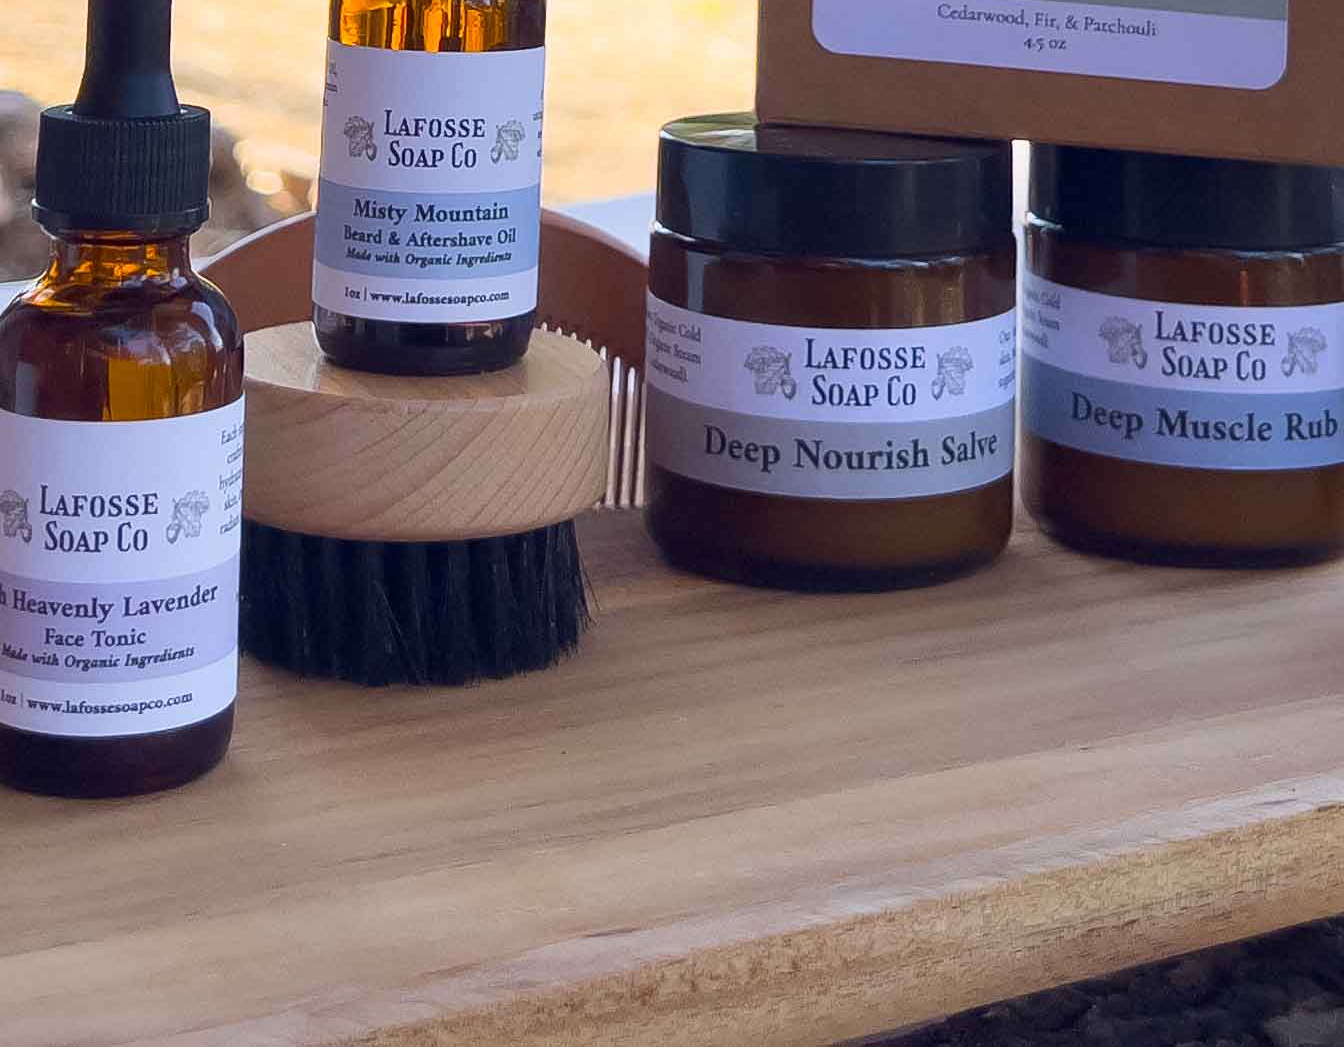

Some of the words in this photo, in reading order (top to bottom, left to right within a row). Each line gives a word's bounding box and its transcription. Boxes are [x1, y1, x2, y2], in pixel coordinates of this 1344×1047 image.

[937, 3, 1030, 29] Cedarwood,
[1034, 6, 1061, 32] Fir,
[1065, 14, 1080, 32] &
[1083, 15, 1158, 37] Patchouli
[1049, 38, 1067, 51] oz
[353, 199, 409, 225] Misty
[414, 204, 509, 223] Mountain
[344, 225, 383, 245] Beard
[389, 231, 401, 246] &
[406, 231, 493, 247] Aftershave
[497, 227, 517, 244] Oil
[346, 247, 372, 261] Made
[375, 251, 401, 264] with
[406, 253, 453, 268] Organic
[456, 252, 512, 267] Ingredients
[370, 290, 510, 307] www.lafossesoapco.com
[1071, 392, 1144, 440] Deep
[1156, 408, 1273, 442] Muscle
[1284, 410, 1339, 442] Rub
[704, 424, 781, 473] Deep
[793, 438, 930, 471] Nourish
[941, 431, 998, 466] Salve
[13, 588, 114, 624] Heavenly
[123, 584, 218, 618] Lavender
[44, 627, 85, 647] Face
[90, 628, 147, 648] Tonic
[1, 642, 28, 662] Made
[32, 650, 59, 667] with
[64, 655, 121, 672] Organic
[124, 646, 195, 669] Ingredients
[27, 691, 193, 715] www.lafossesoapco.com
